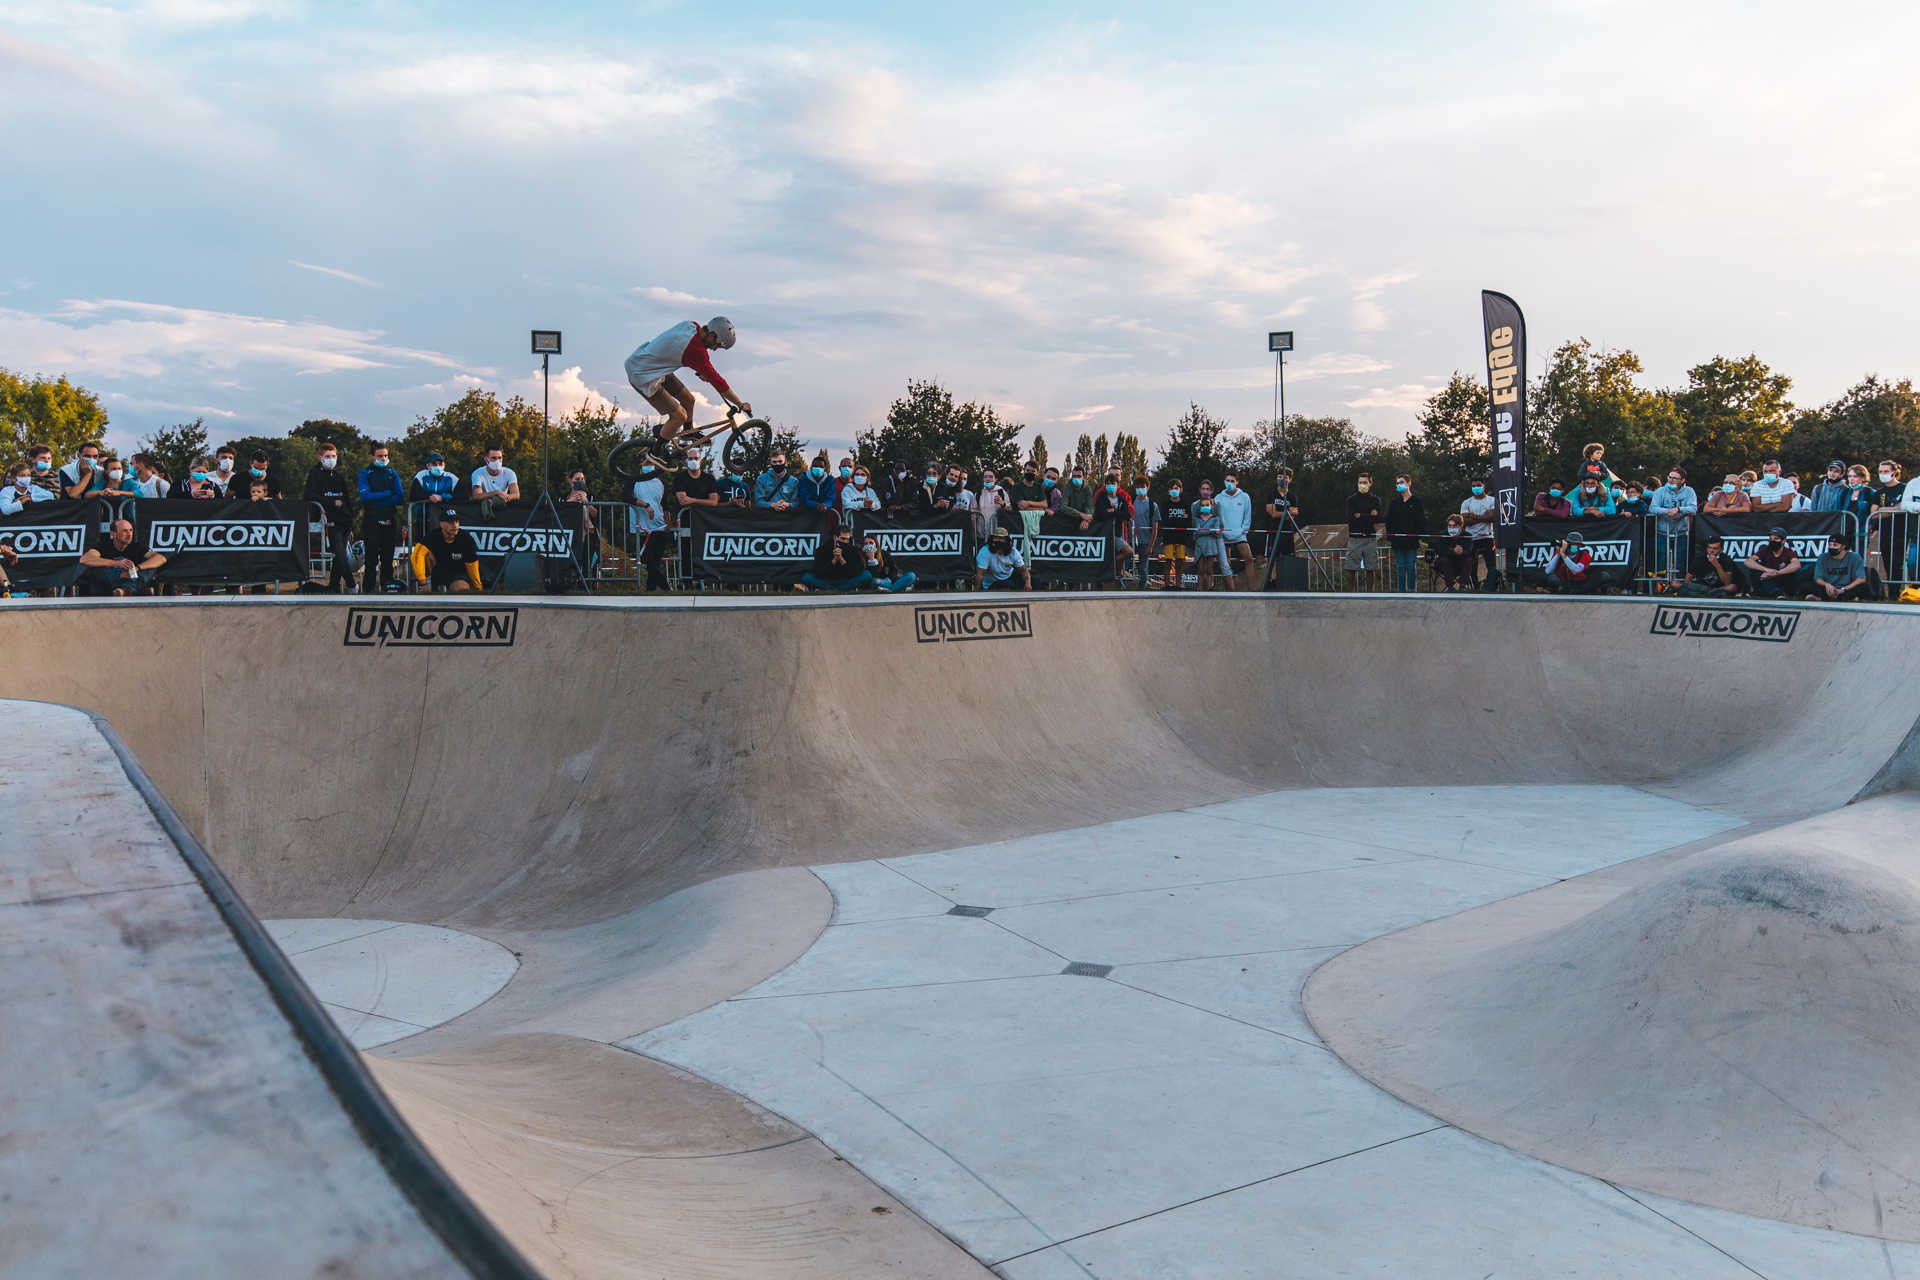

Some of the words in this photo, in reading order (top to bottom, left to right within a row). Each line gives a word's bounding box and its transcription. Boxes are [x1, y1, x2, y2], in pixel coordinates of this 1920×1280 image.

[157, 526, 288, 553] UNICORN
[469, 531, 567, 552] NICORN
[709, 537, 815, 562] UNICORN
[1827, 566, 1849, 576] VANS
[354, 614, 510, 649] UNICORN
[921, 610, 1027, 644] UNICORN
[1659, 610, 1792, 638] UNICORN
